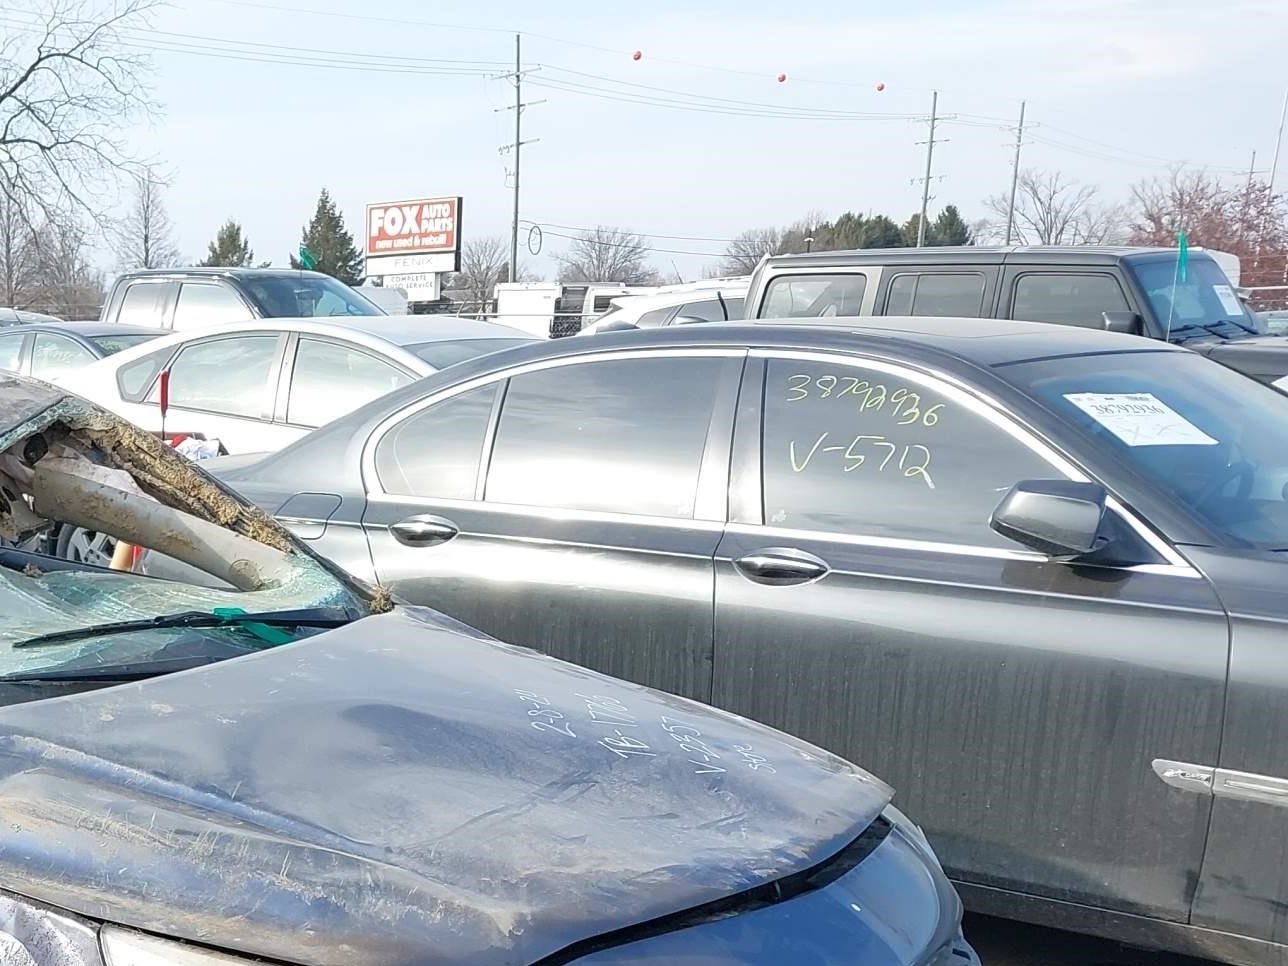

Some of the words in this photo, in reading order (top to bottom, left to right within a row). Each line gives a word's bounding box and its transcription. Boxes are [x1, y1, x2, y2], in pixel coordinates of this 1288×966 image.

[422, 203, 451, 218] AUTO
[371, 206, 421, 237] FOX
[421, 217, 453, 233] PARTS
[375, 239, 393, 250] new
[393, 236, 414, 248] used
[414, 235, 421, 247] &
[394, 256, 433, 268] FENIX
[391, 275, 426, 283] COMPLETE
[406, 281, 433, 289] SERVICE
[785, 374, 945, 427] 38792936
[789, 432, 936, 489] V-5712
